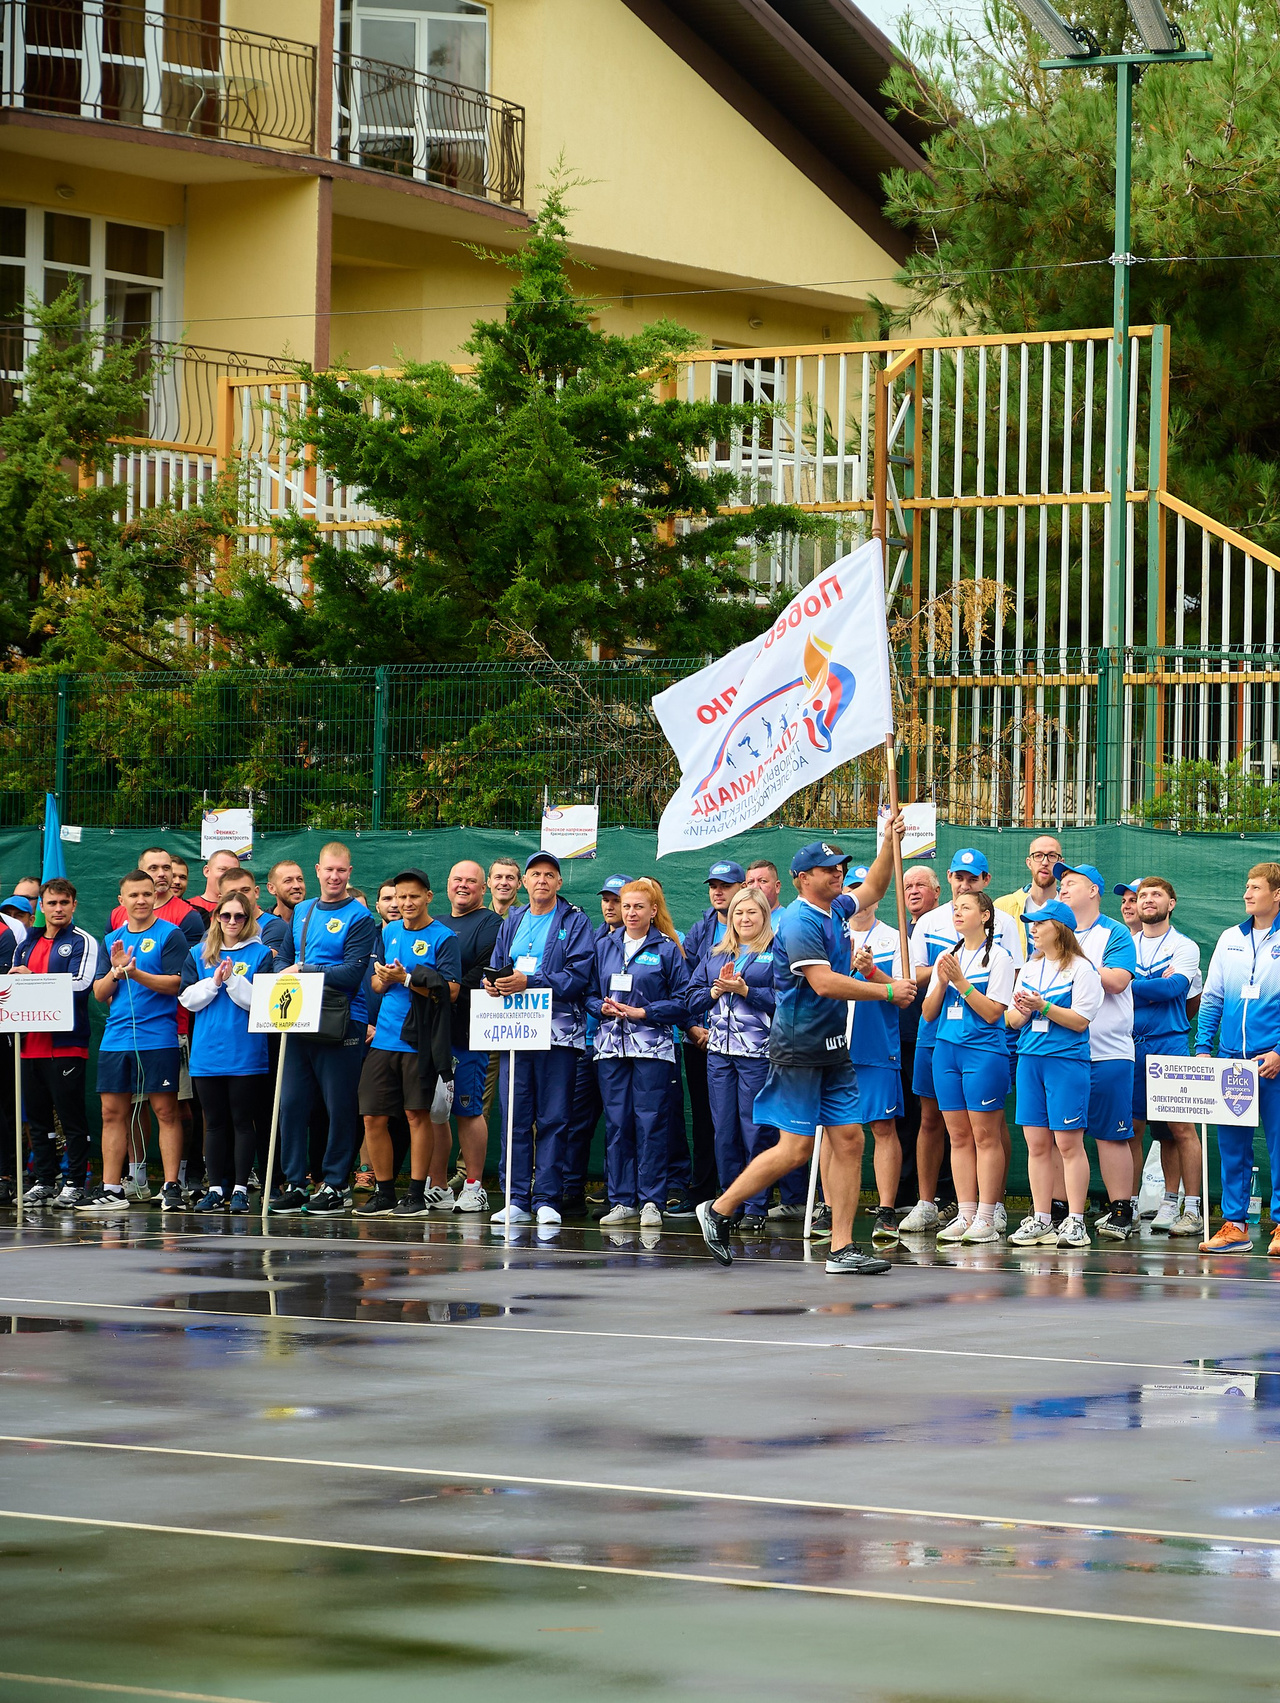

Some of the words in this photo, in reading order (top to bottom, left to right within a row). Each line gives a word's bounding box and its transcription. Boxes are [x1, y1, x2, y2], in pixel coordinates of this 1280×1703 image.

[503, 992, 550, 1010] DRIVE
[0, 1008, 62, 1022] Феникс
[484, 1022, 538, 1042] «ДРАЙВ»
[1164, 1064, 1214, 1074] ЭЛЕКТРОСЕТИ
